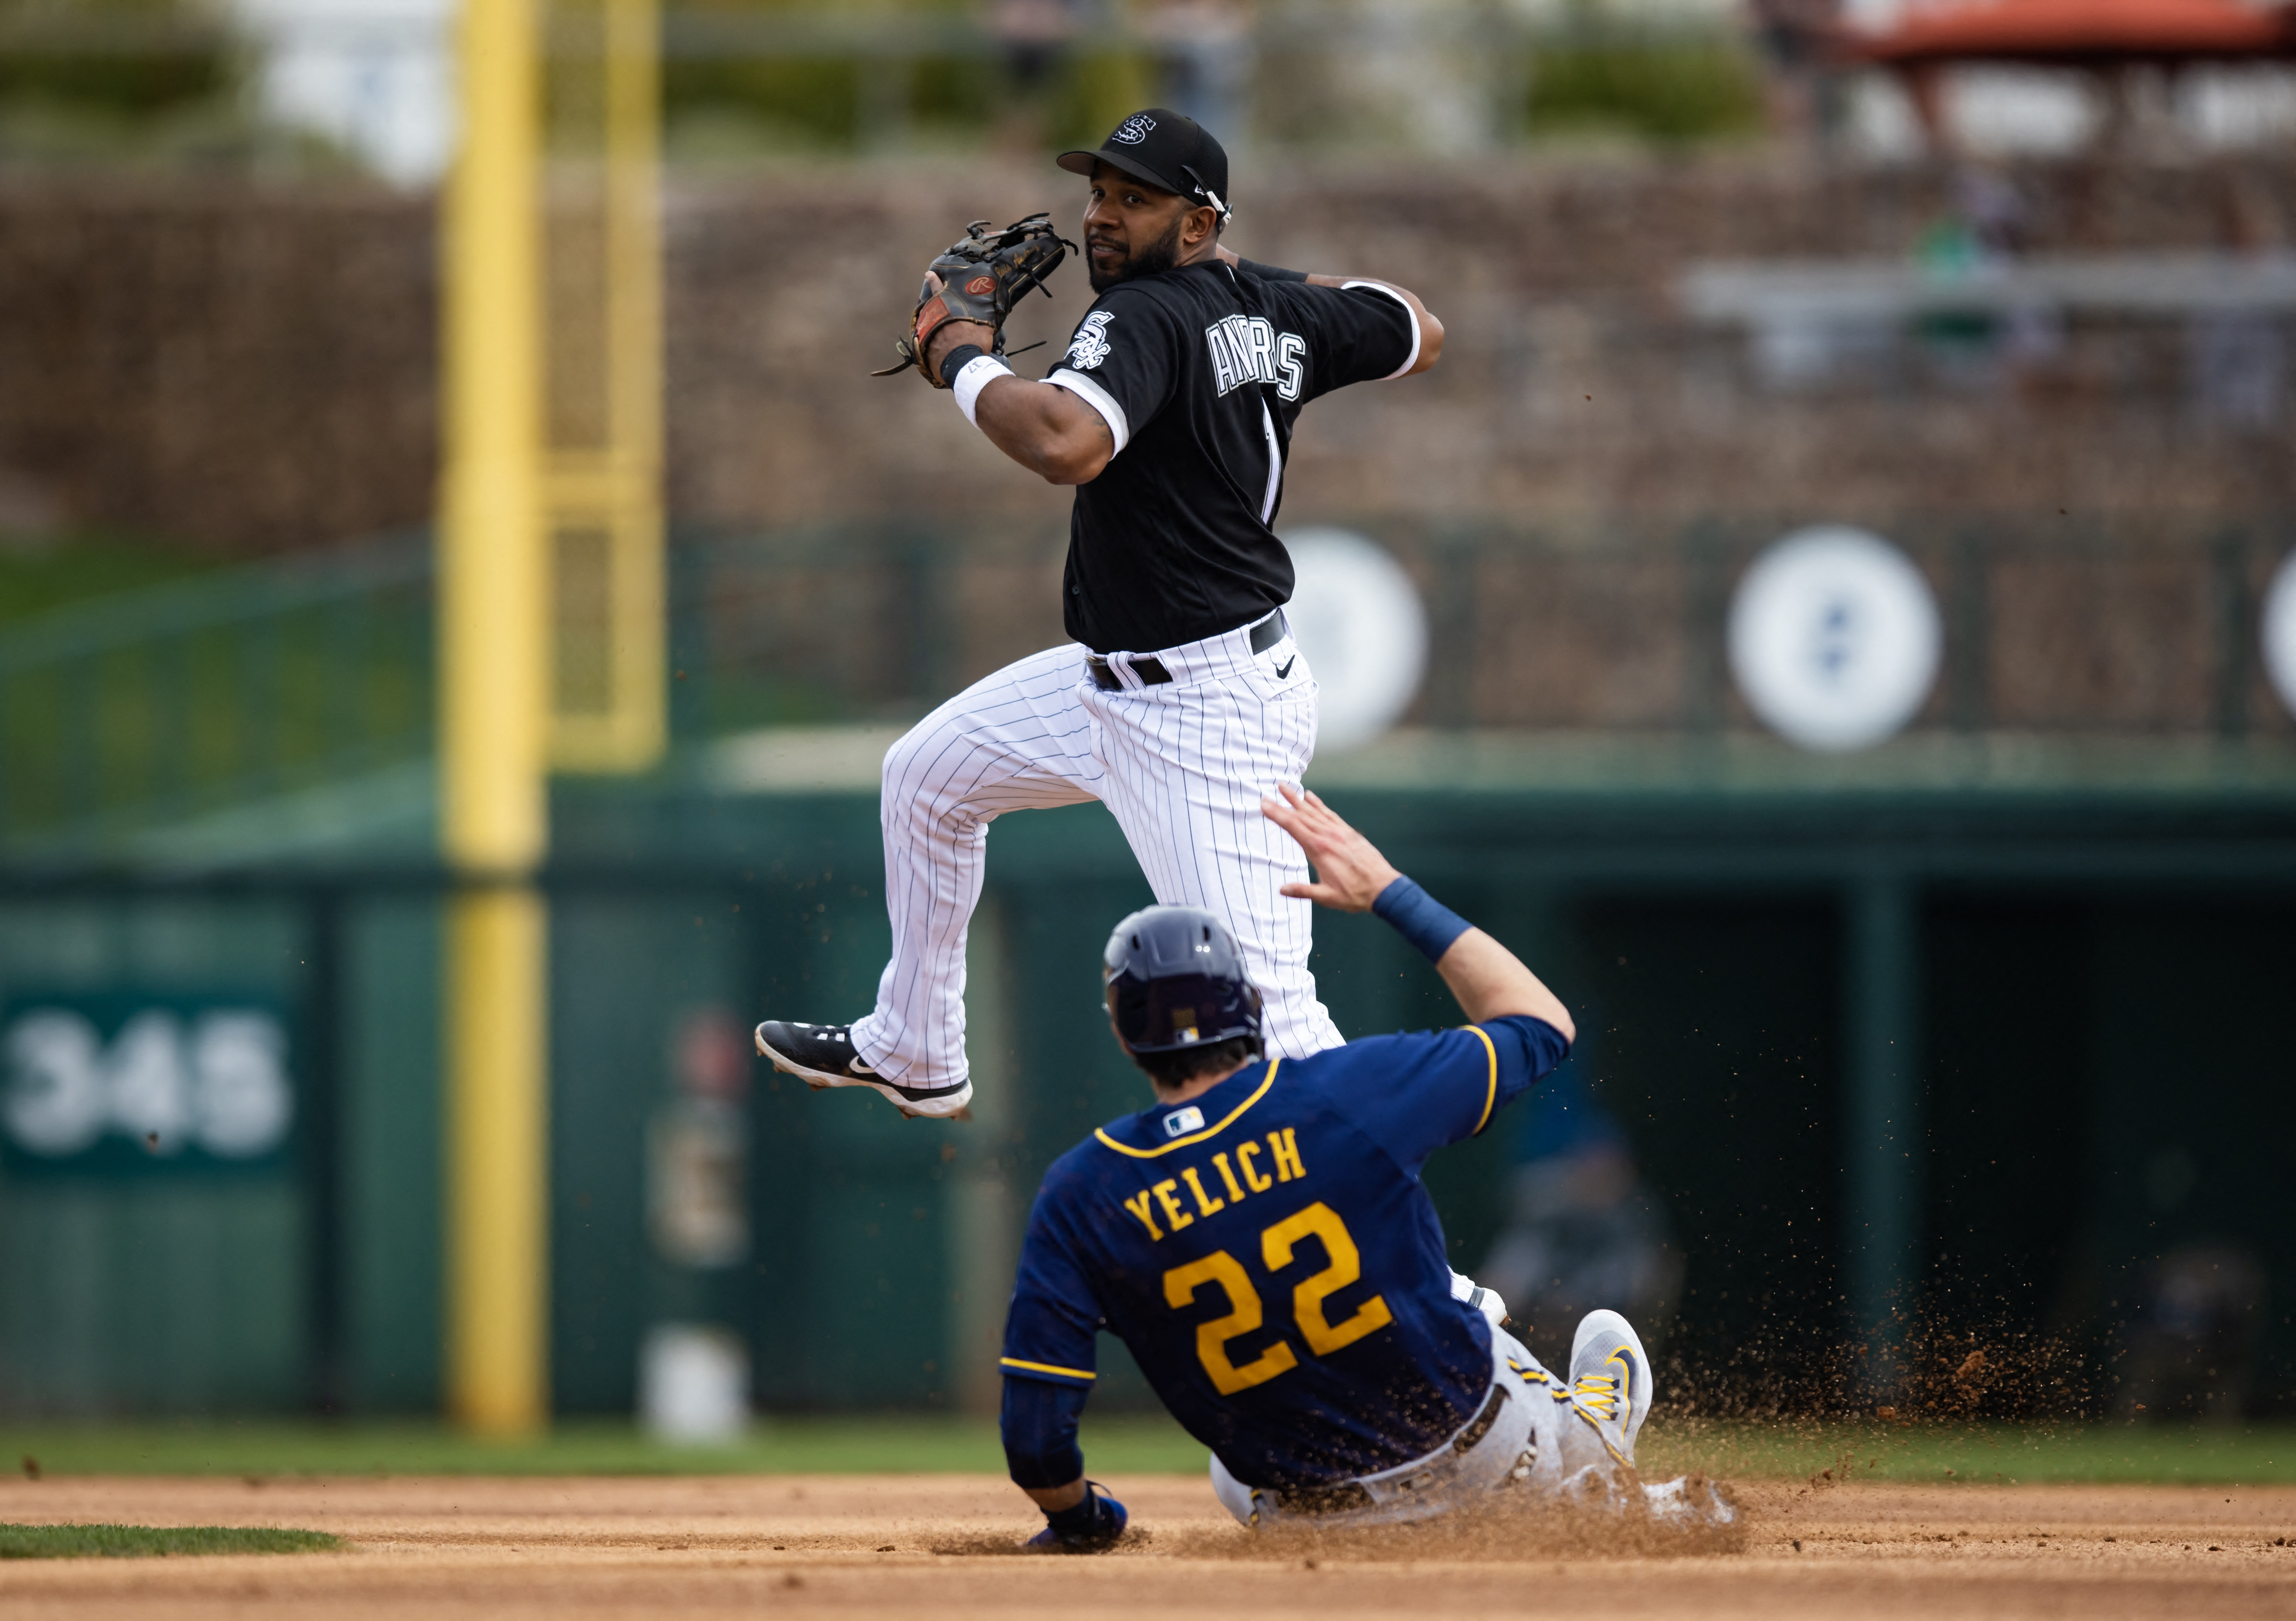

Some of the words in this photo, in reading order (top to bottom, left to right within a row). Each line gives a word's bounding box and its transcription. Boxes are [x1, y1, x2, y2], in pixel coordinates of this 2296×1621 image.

[3, 1005, 297, 1157] 345
[1124, 1127, 1307, 1242] YELICH
[1163, 1200, 1393, 1397] 22
